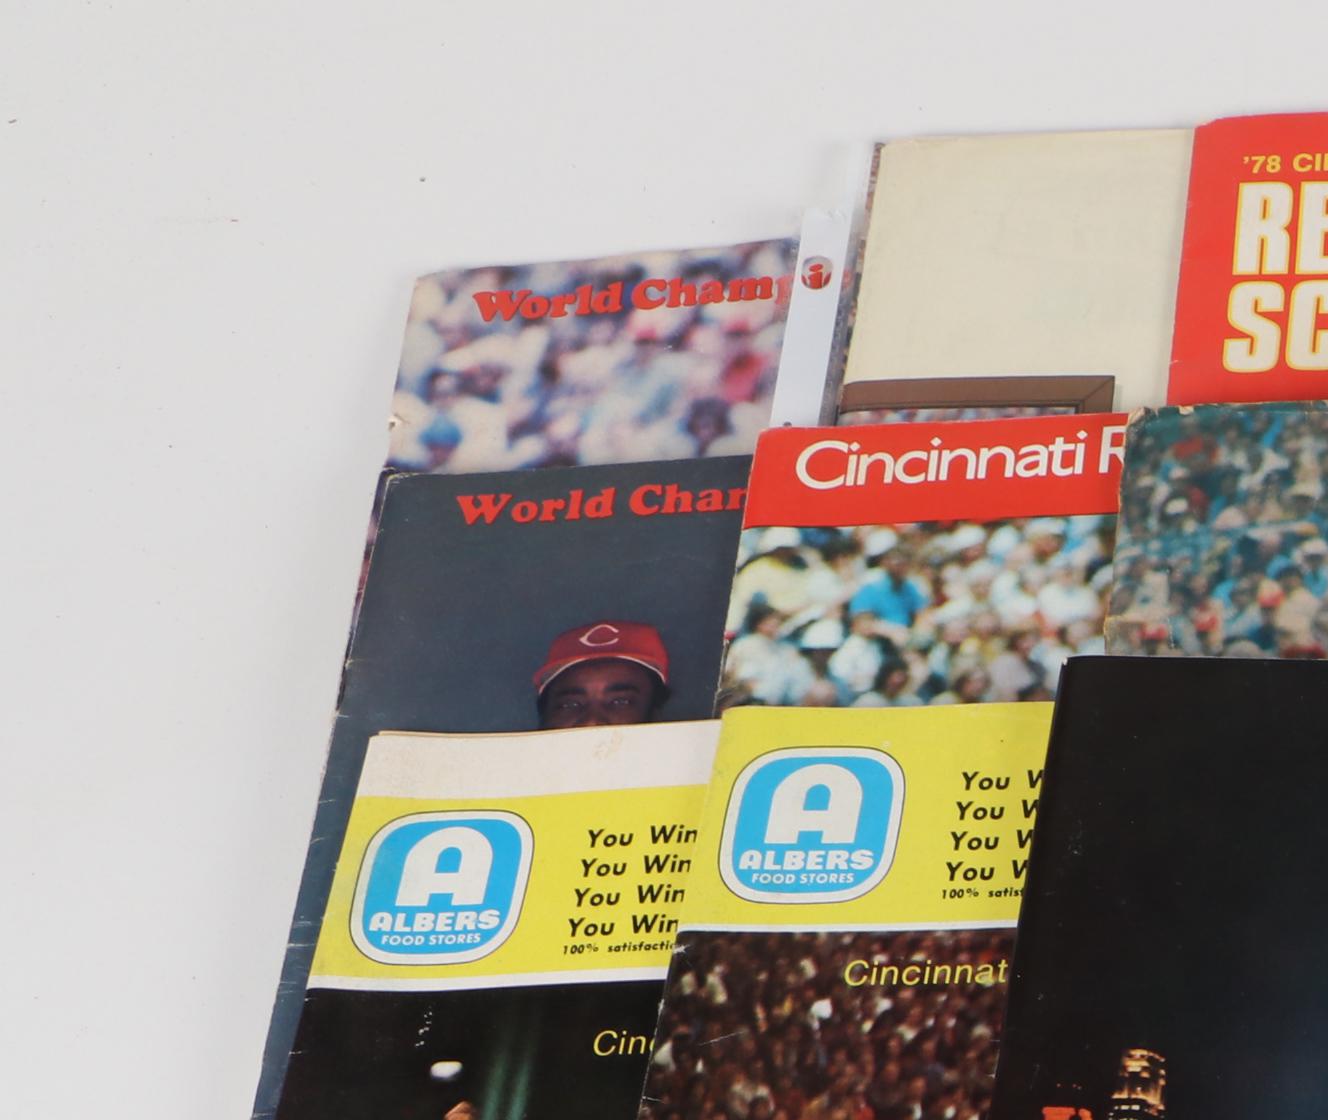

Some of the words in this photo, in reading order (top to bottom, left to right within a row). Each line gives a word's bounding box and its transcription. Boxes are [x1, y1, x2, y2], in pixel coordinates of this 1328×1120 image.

[472, 277, 624, 322] World
[795, 429, 1086, 491] Cincinnati
[455, 488, 614, 526] World
[588, 829, 634, 848] You
[650, 824, 698, 844] Win
[581, 858, 627, 878] You
[643, 854, 692, 874] Win
[738, 849, 874, 871] ALBERS
[945, 861, 995, 882] You
[751, 873, 796, 884] FOOD
[799, 872, 855, 884] STORES
[574, 887, 621, 908] You
[637, 883, 686, 904] Win
[368, 908, 500, 932] ALBERS
[568, 917, 615, 938] You
[631, 913, 679, 934] Win
[381, 934, 425, 946] FOOD
[428, 932, 481, 945] STORES
